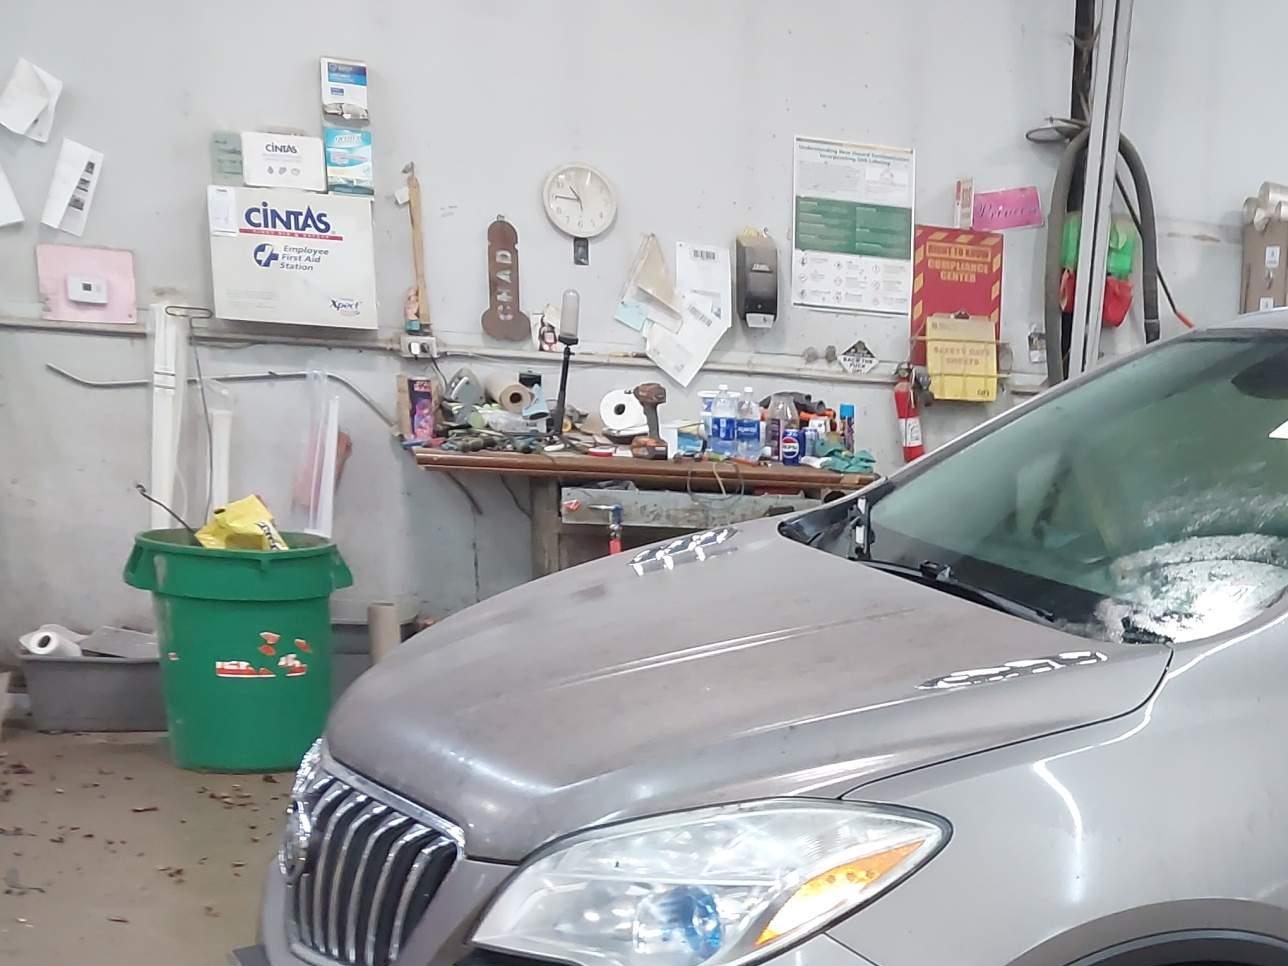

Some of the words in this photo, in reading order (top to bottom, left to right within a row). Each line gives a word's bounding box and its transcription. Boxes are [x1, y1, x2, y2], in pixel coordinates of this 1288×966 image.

[283, 245, 330, 256] Employee
[282, 253, 302, 261] First
[304, 255, 321, 263] Aid
[280, 262, 314, 271] Station
[928, 259, 989, 274] COMPLIANCE
[940, 271, 976, 283] CENTER
[496, 249, 512, 320] CHAD
